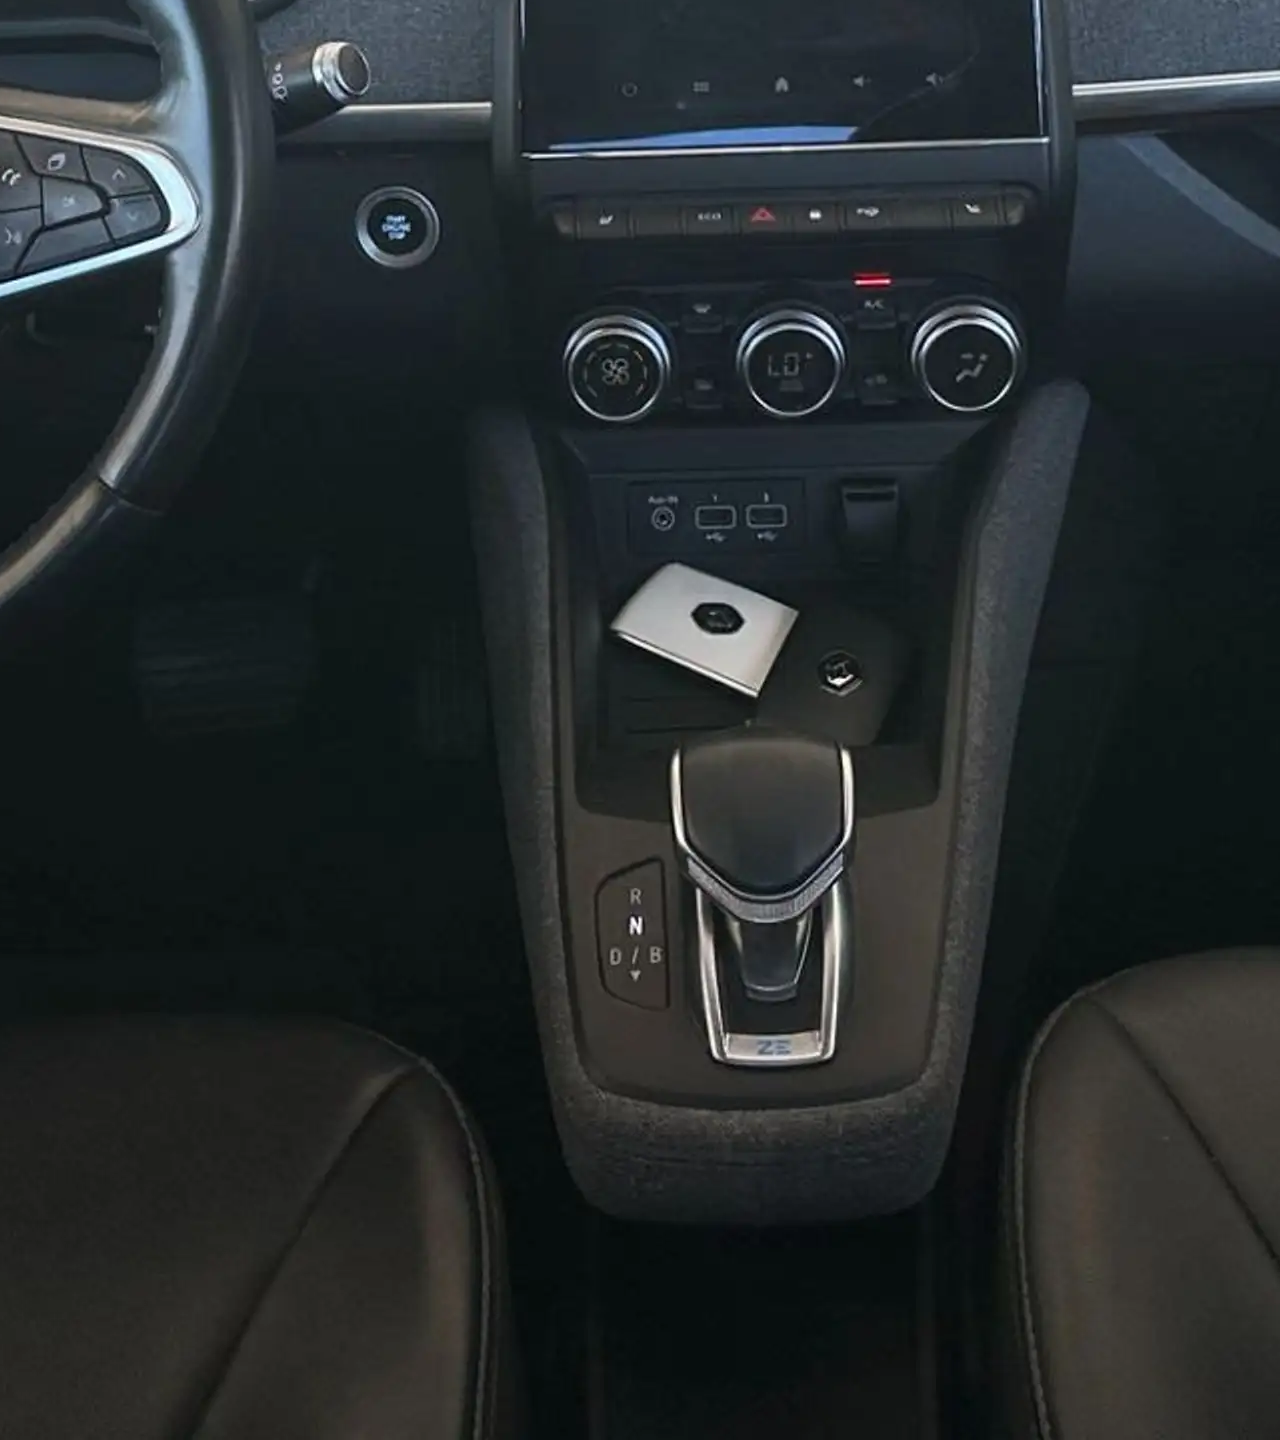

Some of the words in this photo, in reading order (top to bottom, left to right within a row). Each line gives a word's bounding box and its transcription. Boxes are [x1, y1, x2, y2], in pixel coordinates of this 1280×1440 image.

[864, 298, 885, 310] A/C
[630, 888, 642, 905] R
[629, 916, 644, 936] N
[610, 948, 622, 965] D
[650, 946, 663, 963] B
